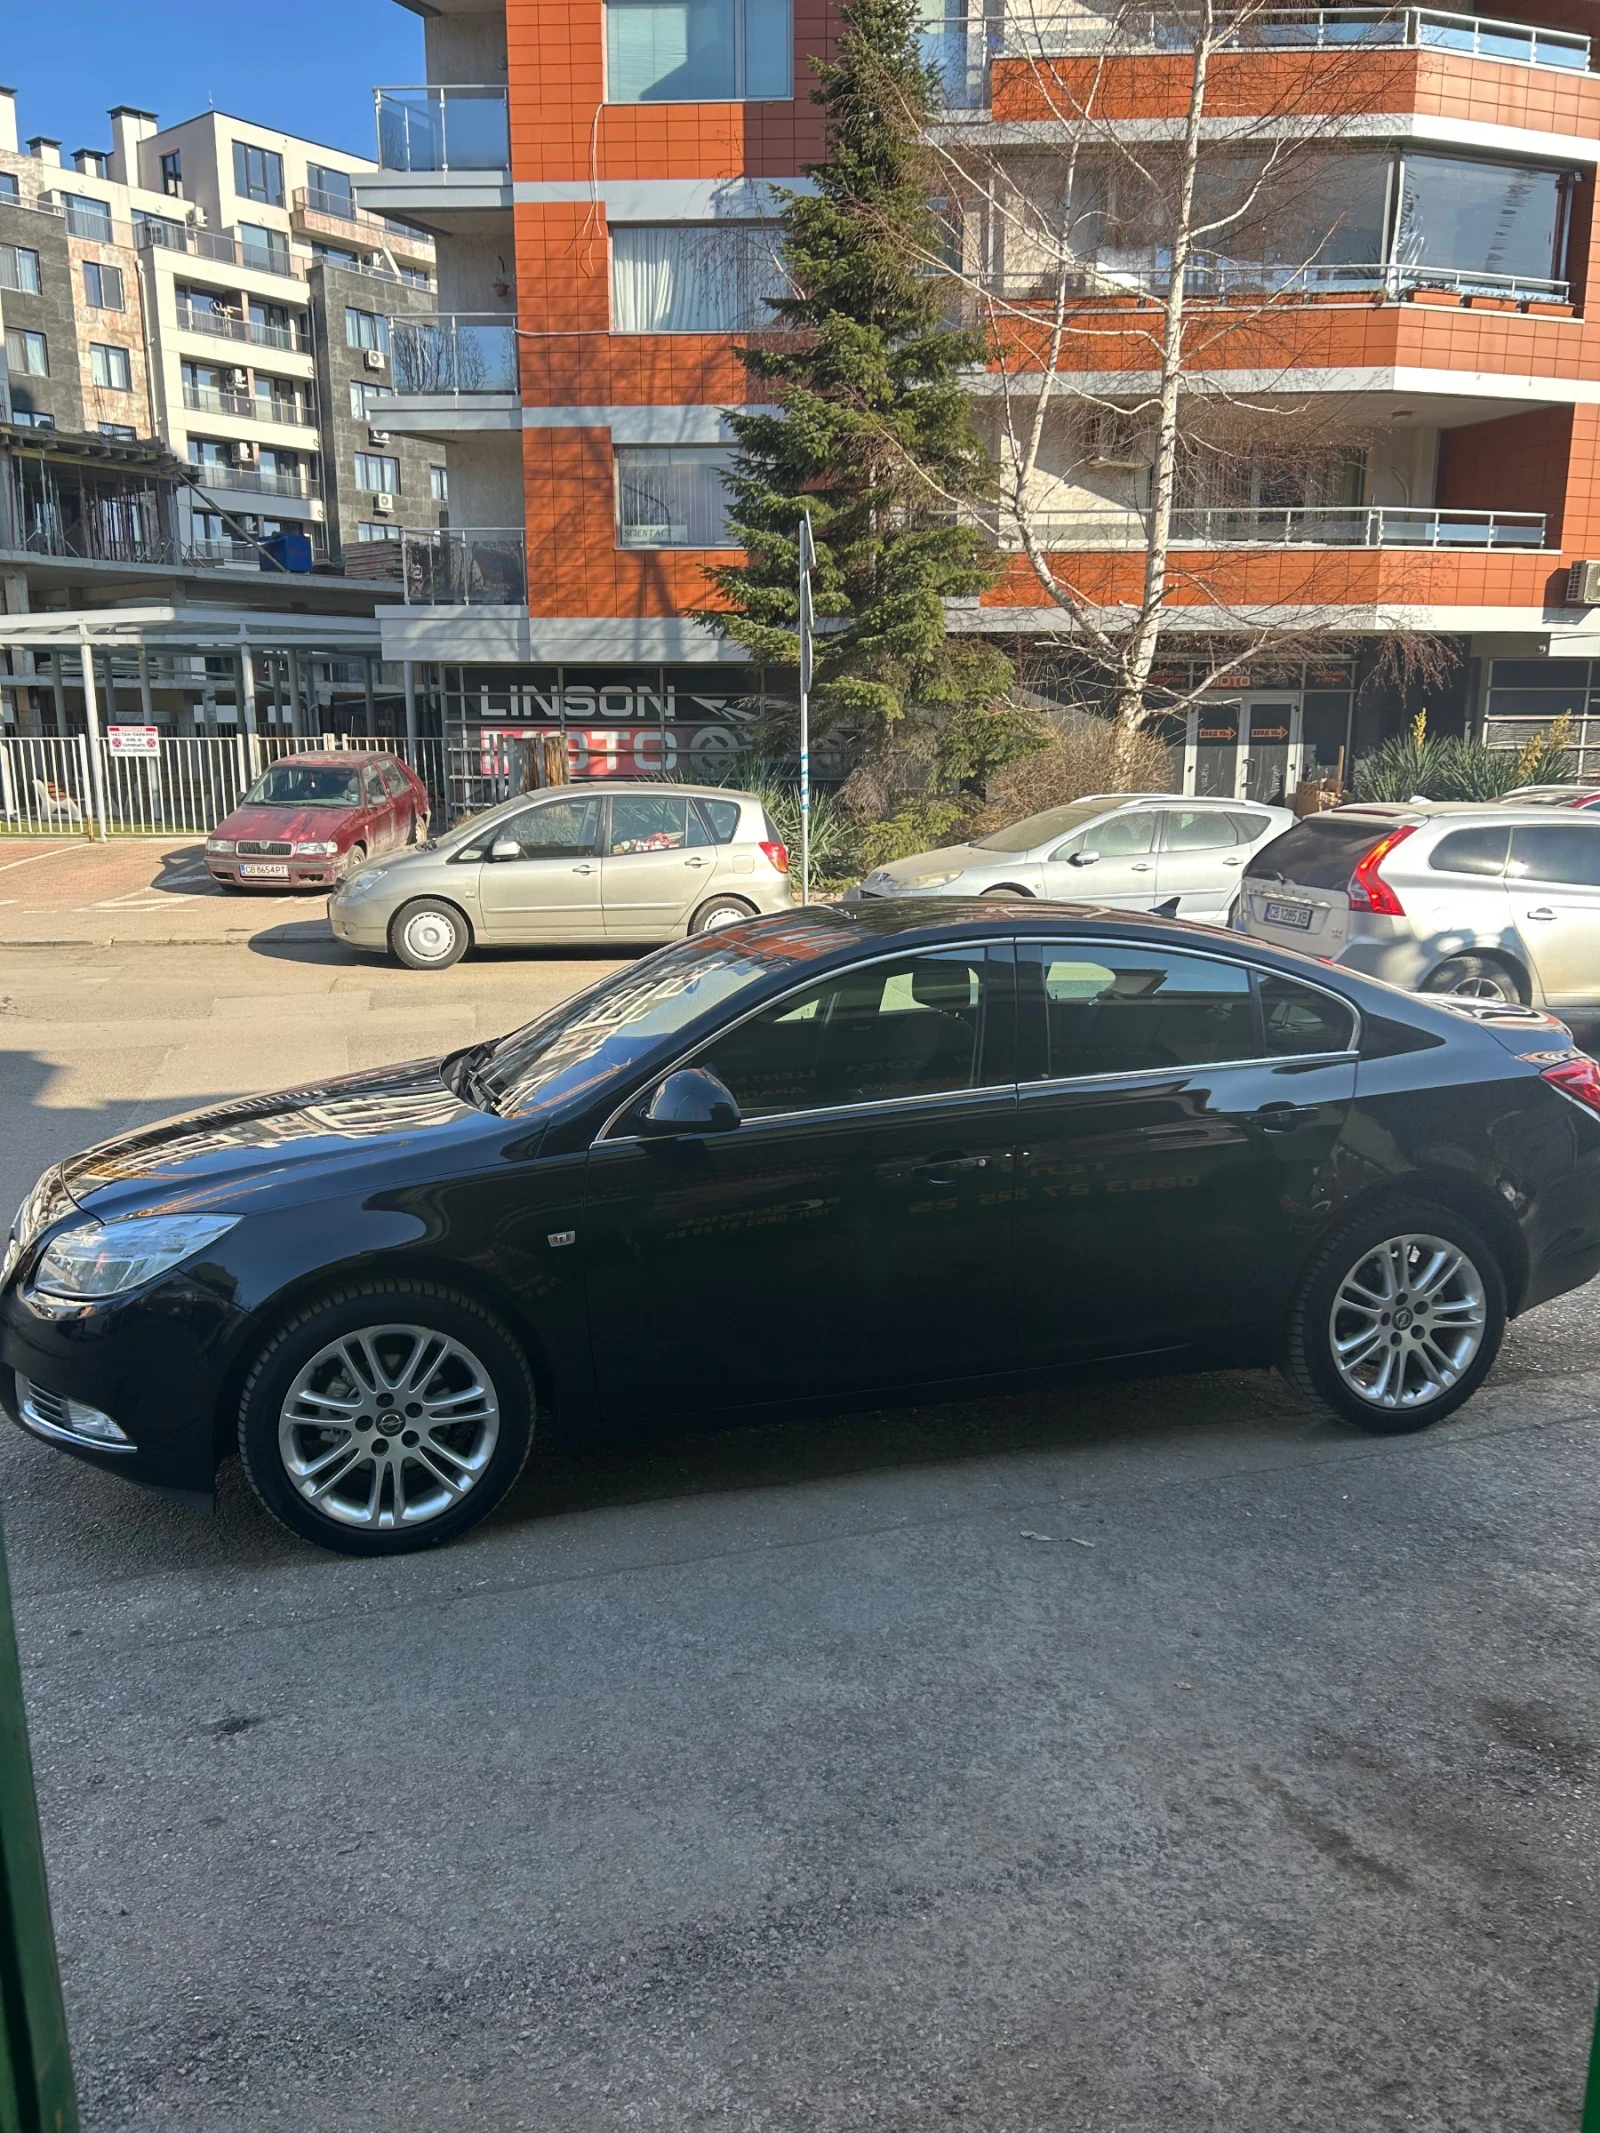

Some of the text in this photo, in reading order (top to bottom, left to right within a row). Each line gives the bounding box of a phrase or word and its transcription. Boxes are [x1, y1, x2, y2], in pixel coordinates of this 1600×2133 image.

[1206, 666, 1253, 675] LSON
[481, 685, 675, 717] LINSON
[257, 866, 275, 874] 8654
